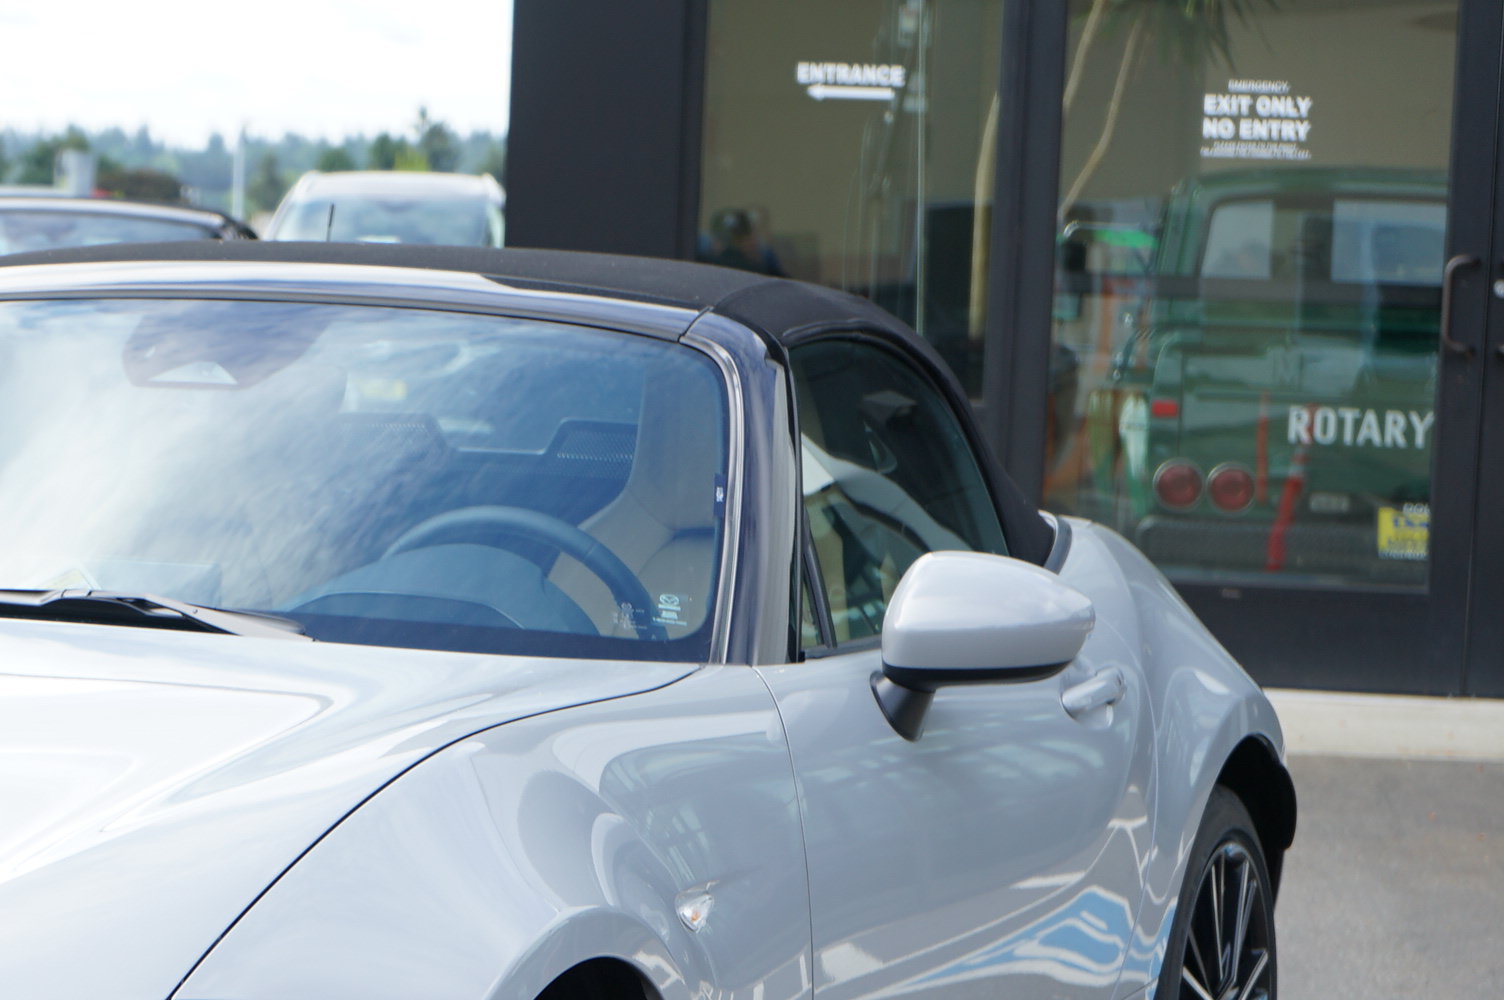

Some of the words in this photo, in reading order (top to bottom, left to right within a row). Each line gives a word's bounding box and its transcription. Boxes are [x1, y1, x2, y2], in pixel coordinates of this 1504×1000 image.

[797, 61, 906, 87] ENTRANCE
[1204, 94, 1252, 116] EXIT
[1256, 95, 1312, 118] ONLY
[1202, 117, 1235, 139] NO
[1239, 118, 1311, 142] ENTRY
[1288, 405, 1434, 449] ROTARY
